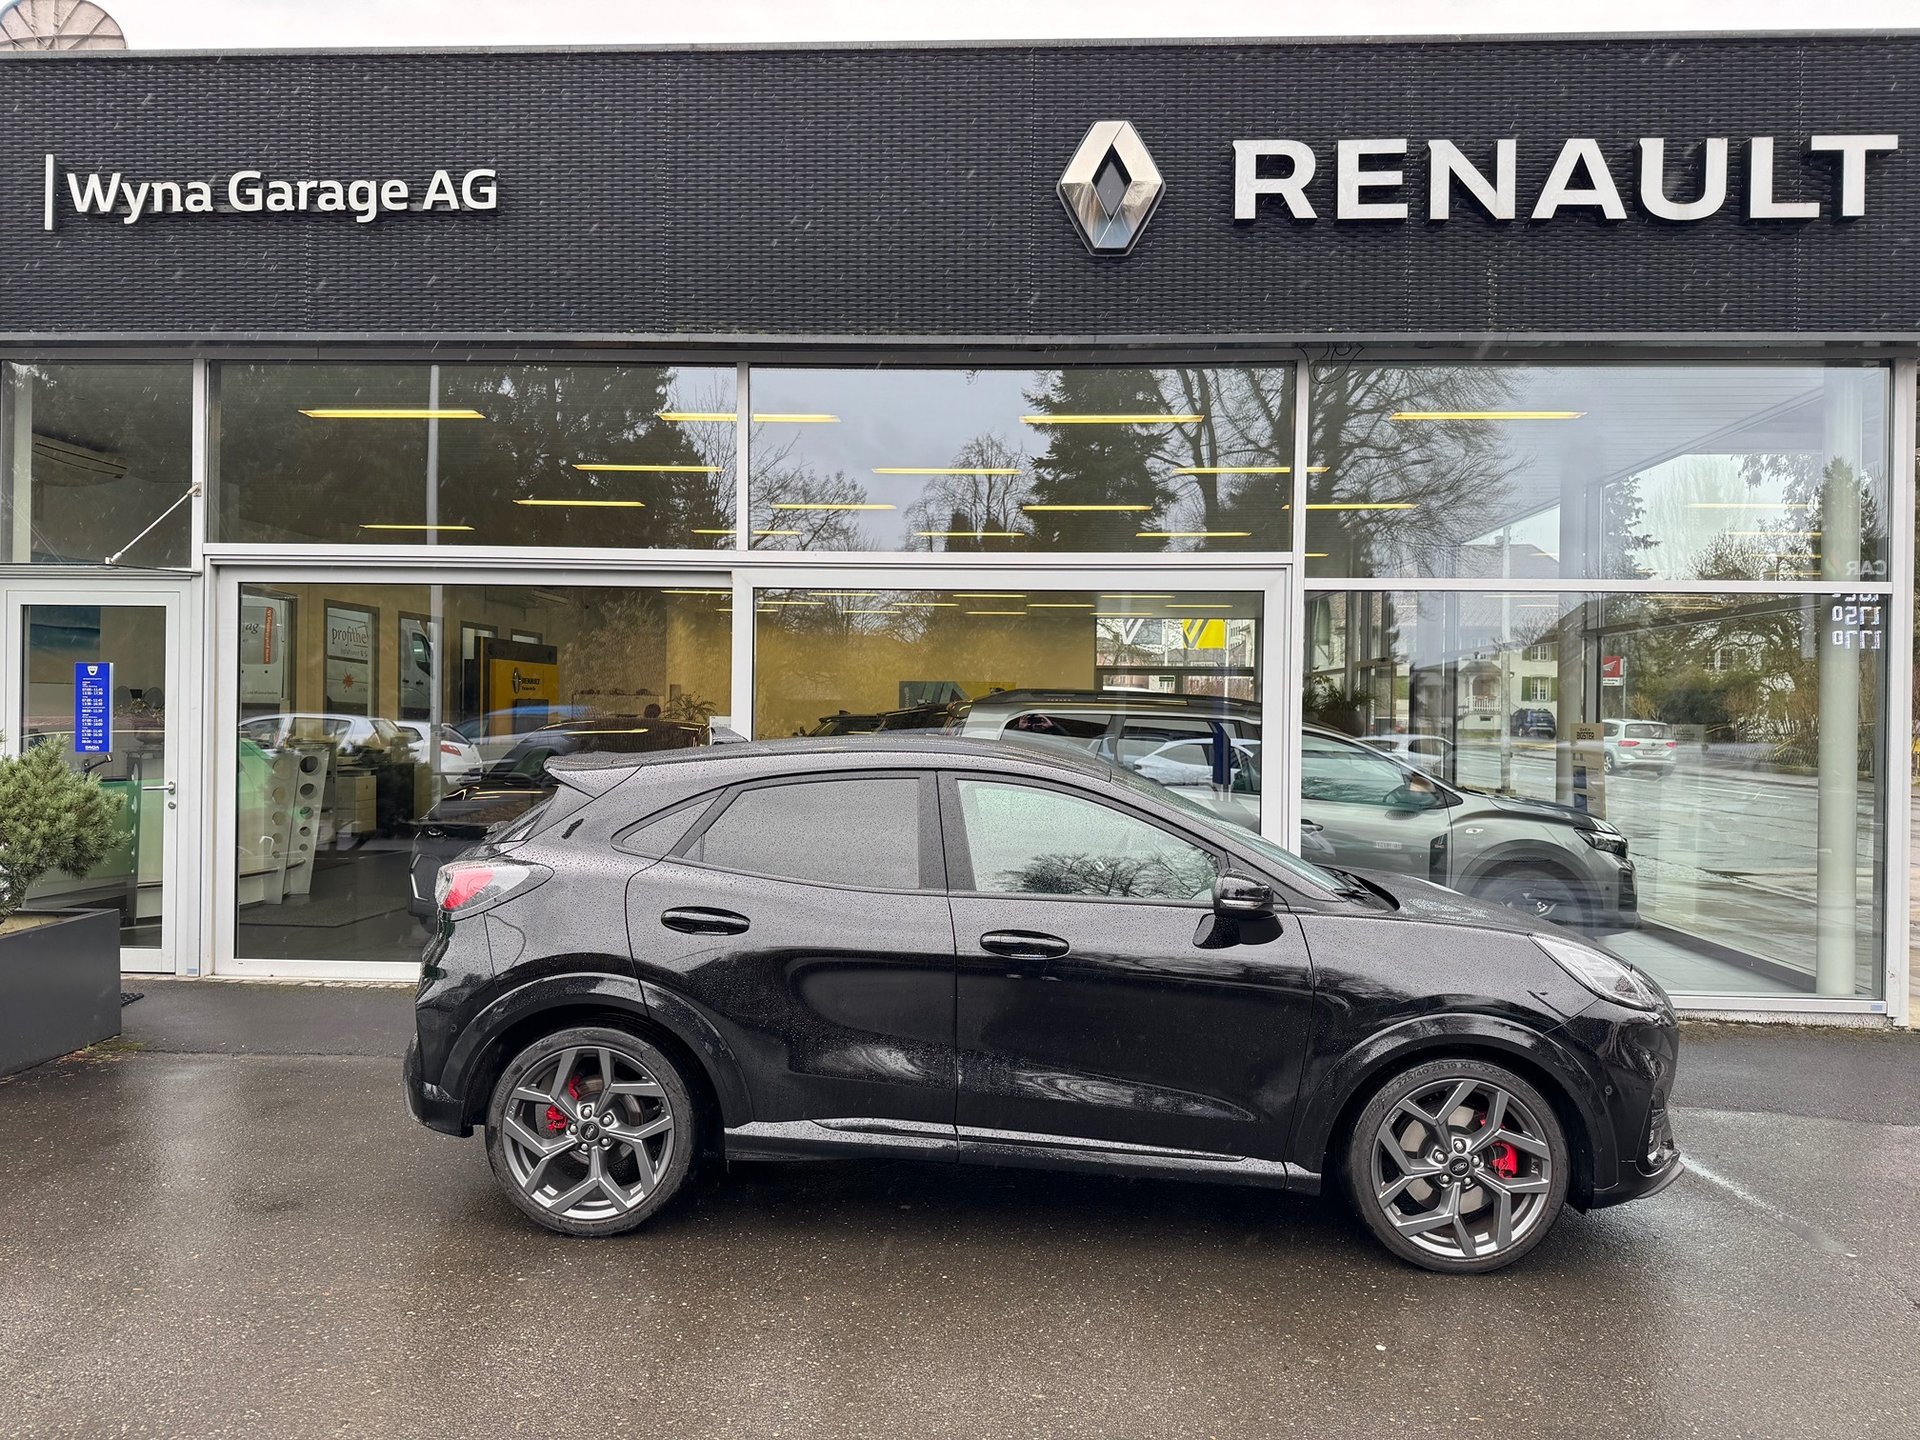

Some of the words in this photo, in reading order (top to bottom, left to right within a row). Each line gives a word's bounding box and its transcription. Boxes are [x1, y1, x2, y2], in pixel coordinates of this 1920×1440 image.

[66, 171, 214, 225] Wyna
[227, 169, 410, 223] Garage
[422, 168, 498, 211] AG
[1232, 134, 1900, 221] RENAULT
